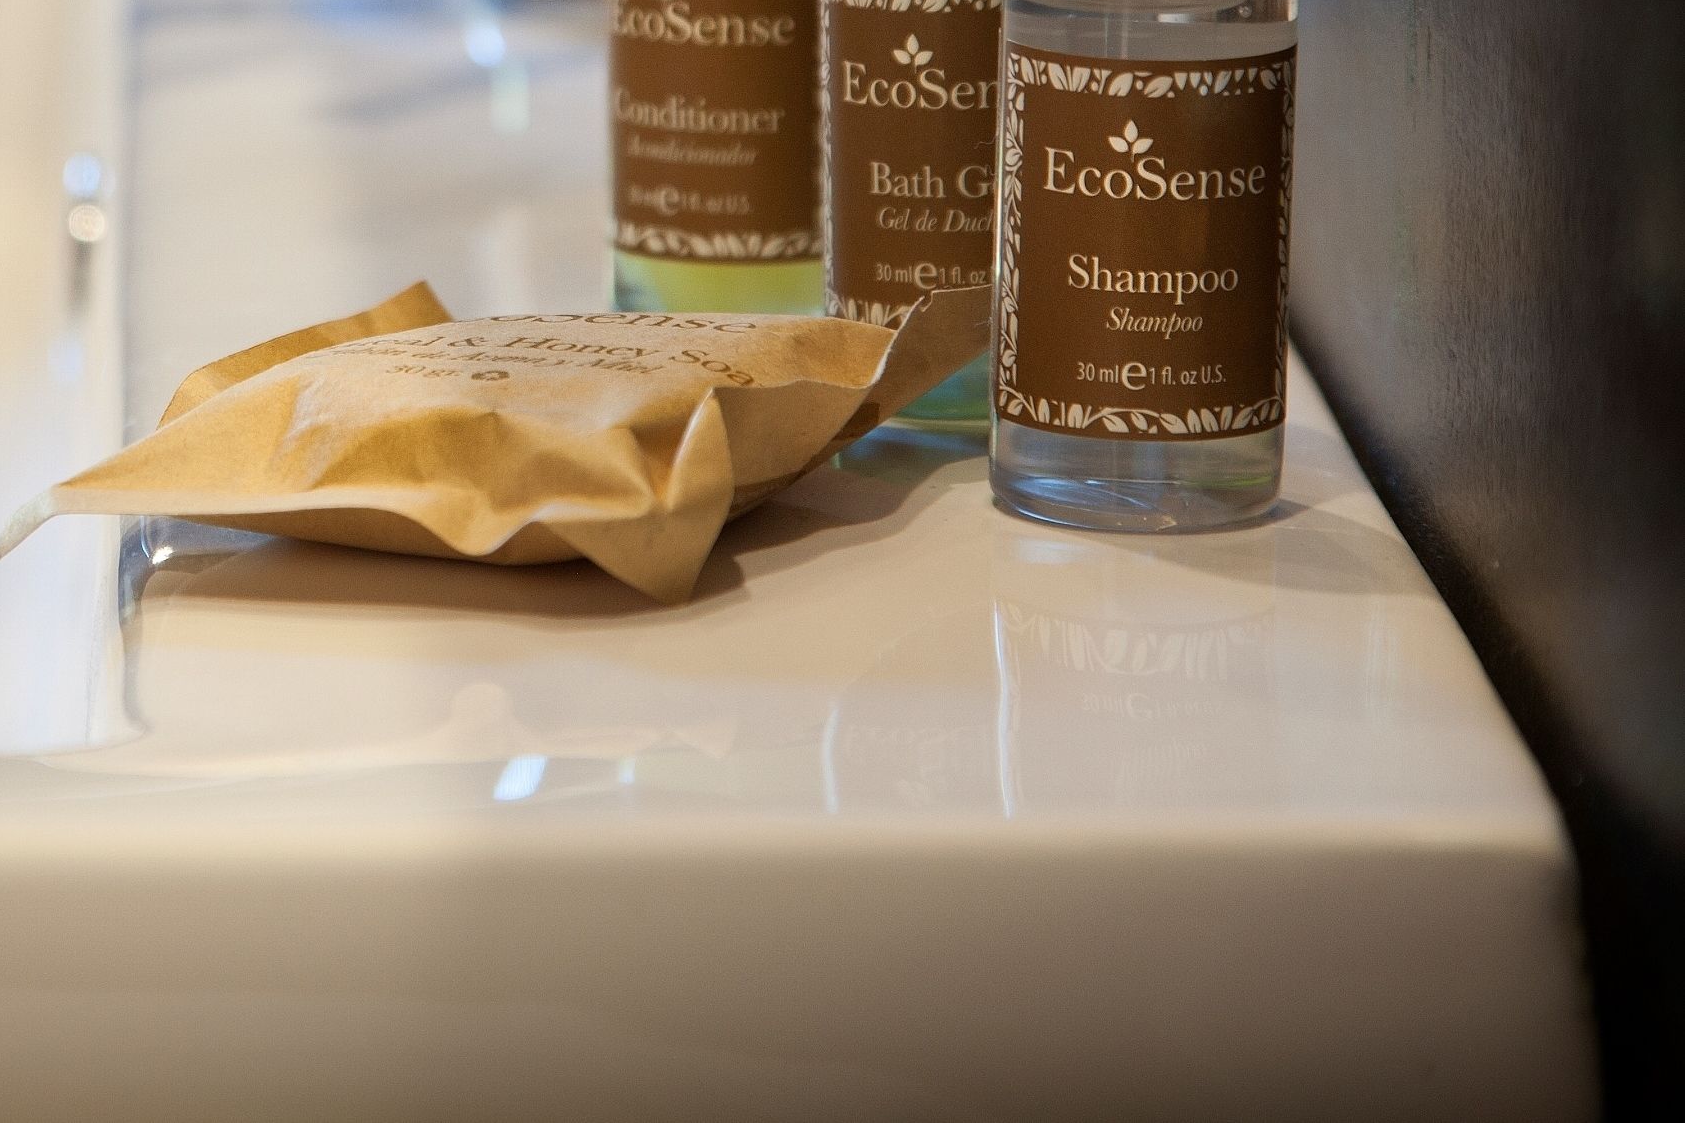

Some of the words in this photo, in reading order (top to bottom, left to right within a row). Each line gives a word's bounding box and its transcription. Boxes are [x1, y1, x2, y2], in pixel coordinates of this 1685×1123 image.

[843, 60, 998, 110] EcoSen
[616, 88, 786, 133] Conditioner
[869, 161, 948, 198] Bath
[1044, 146, 1266, 201] EcoSense
[878, 206, 911, 231] Gel
[914, 208, 938, 232] de
[876, 263, 892, 282] 30
[970, 271, 987, 284] oz
[1067, 253, 1239, 306] Shampoo
[1106, 306, 1204, 340] Shampoo
[446, 336, 488, 348] &
[494, 336, 661, 360] Honey
[668, 349, 756, 386] Soa
[1077, 361, 1096, 382] 30
[1161, 366, 1177, 385] fl.
[1180, 370, 1197, 385] oz
[1201, 364, 1227, 384] U.S.
